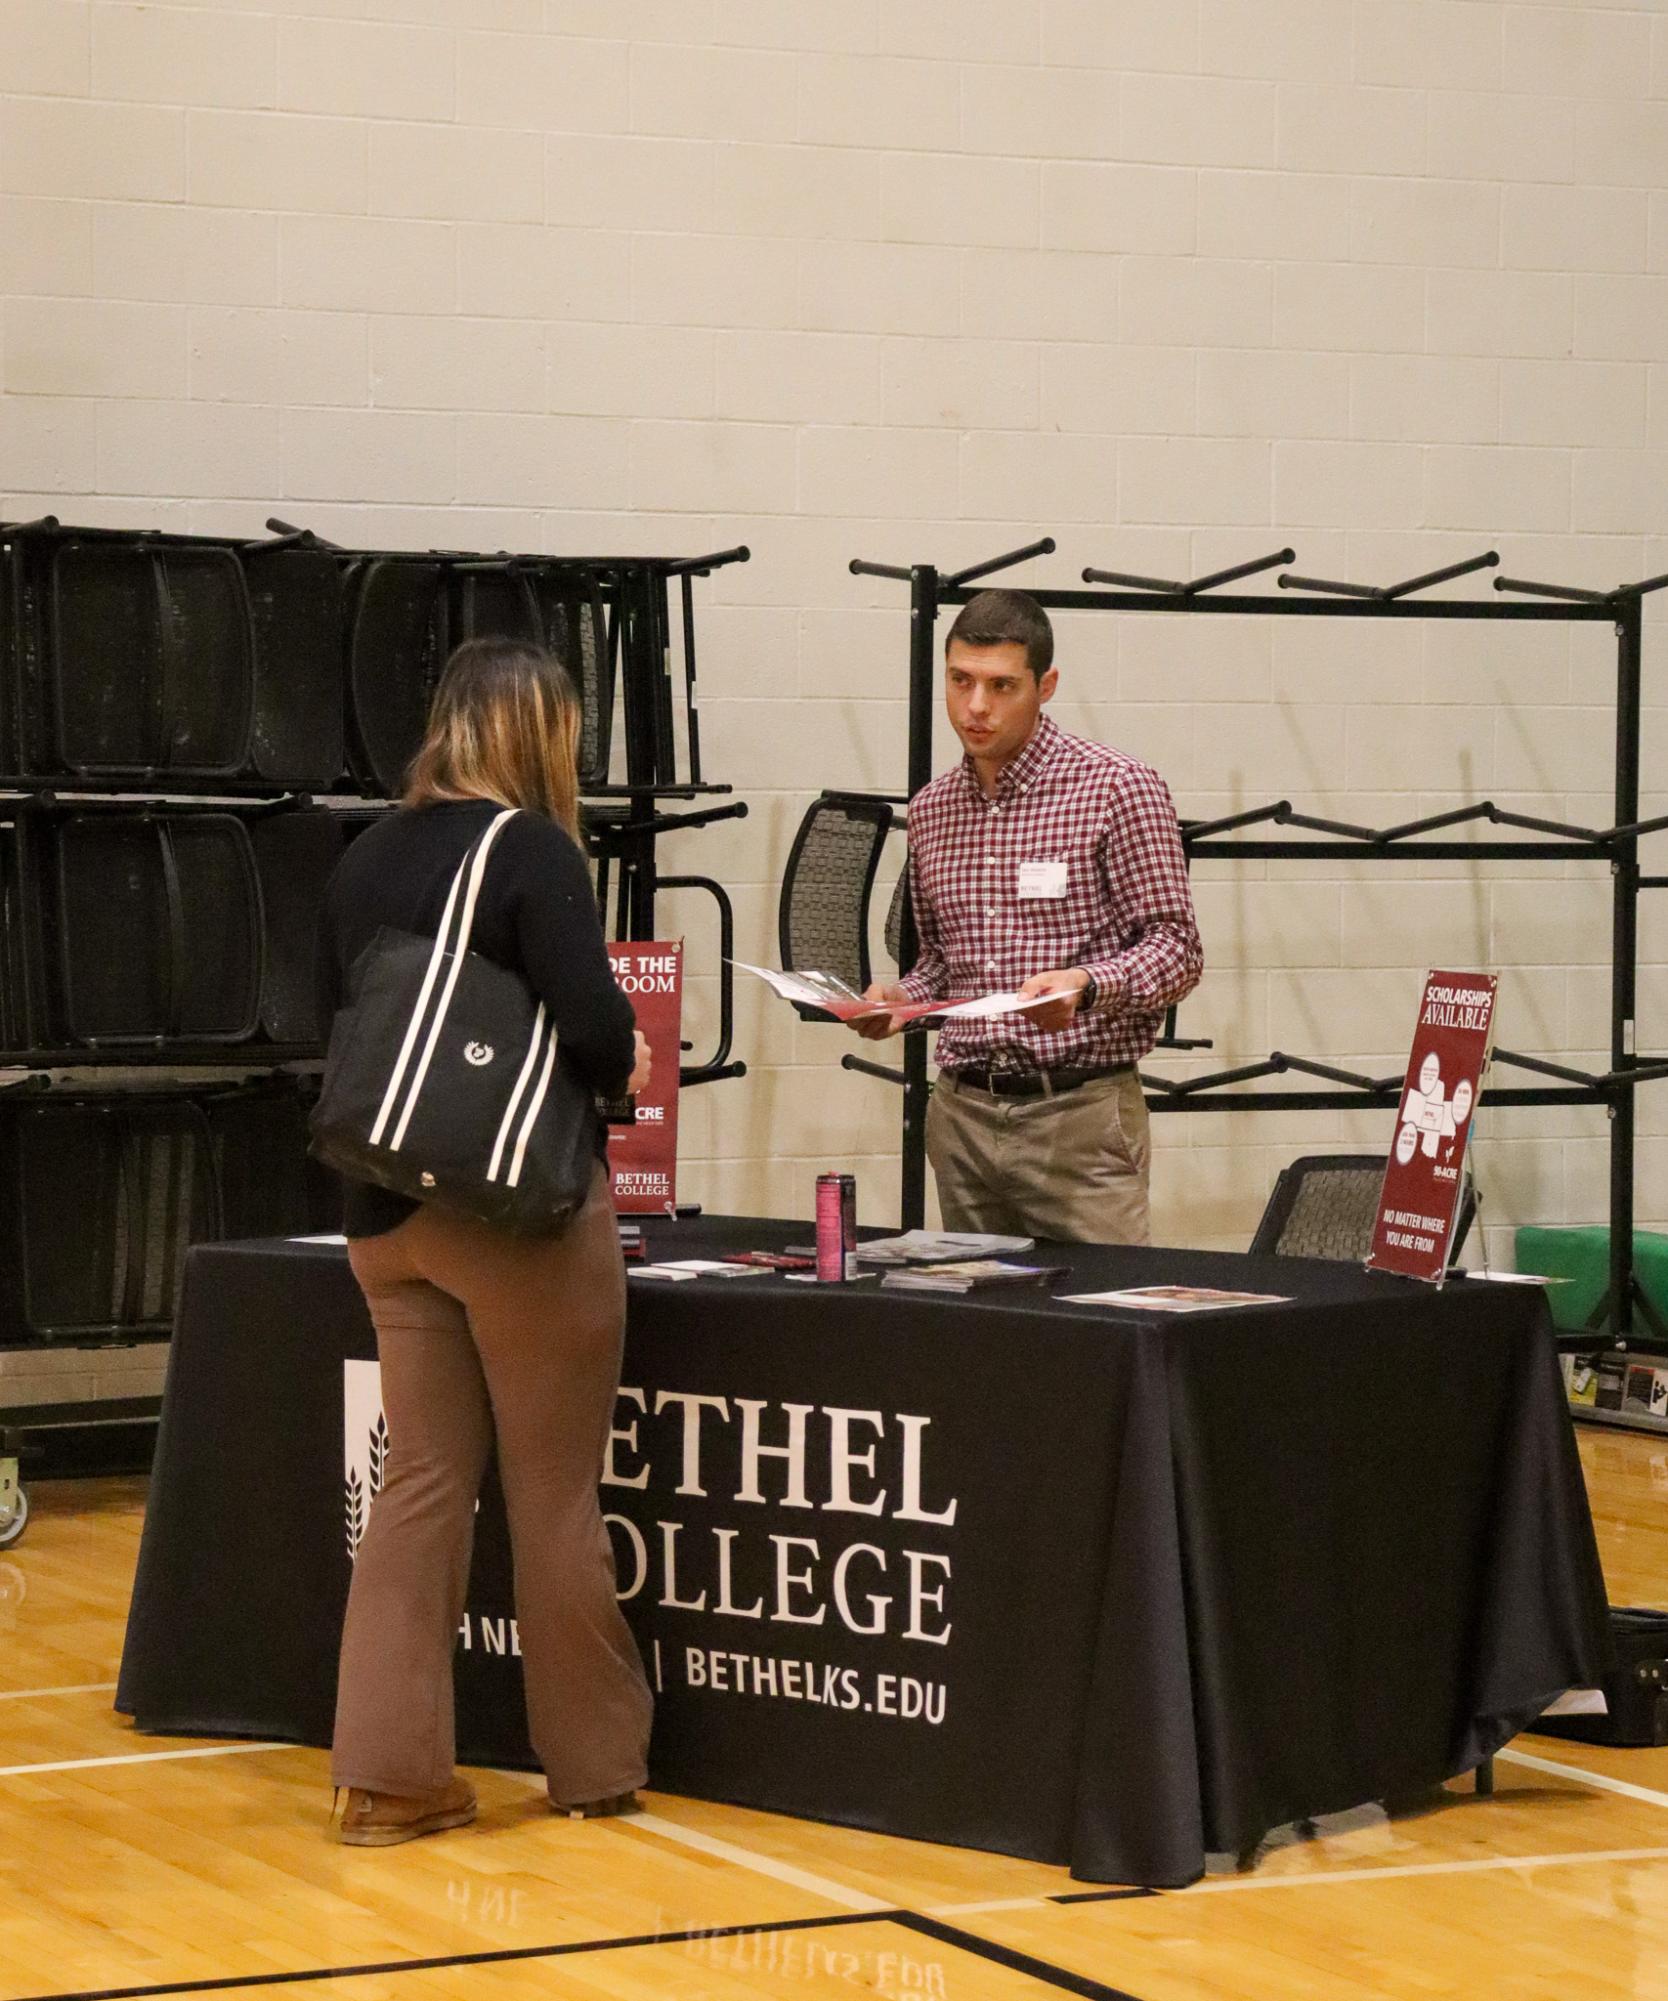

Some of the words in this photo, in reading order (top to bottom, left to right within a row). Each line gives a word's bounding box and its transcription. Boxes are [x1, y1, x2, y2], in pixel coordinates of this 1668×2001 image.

[637, 956, 676, 973] THE
[614, 975, 675, 992] OOM
[1426, 986, 1492, 1008] SCHOLARSHIPS
[1421, 1003, 1489, 1031] AVAILABLE
[616, 1173, 670, 1185] BETHEL
[615, 1185, 669, 1196] COLLEGE
[1383, 1209, 1394, 1224] NO
[1394, 1211, 1421, 1229] MATTER
[1421, 1216, 1446, 1234] WHERE
[1386, 1231, 1400, 1246] YOU
[1400, 1234, 1414, 1249] ARE
[1414, 1236, 1435, 1253] FROM
[600, 1386, 957, 1526] ETHEL
[602, 1513, 951, 1646] OLLEGE
[686, 1647, 946, 1725] BETHELKS.EDU
